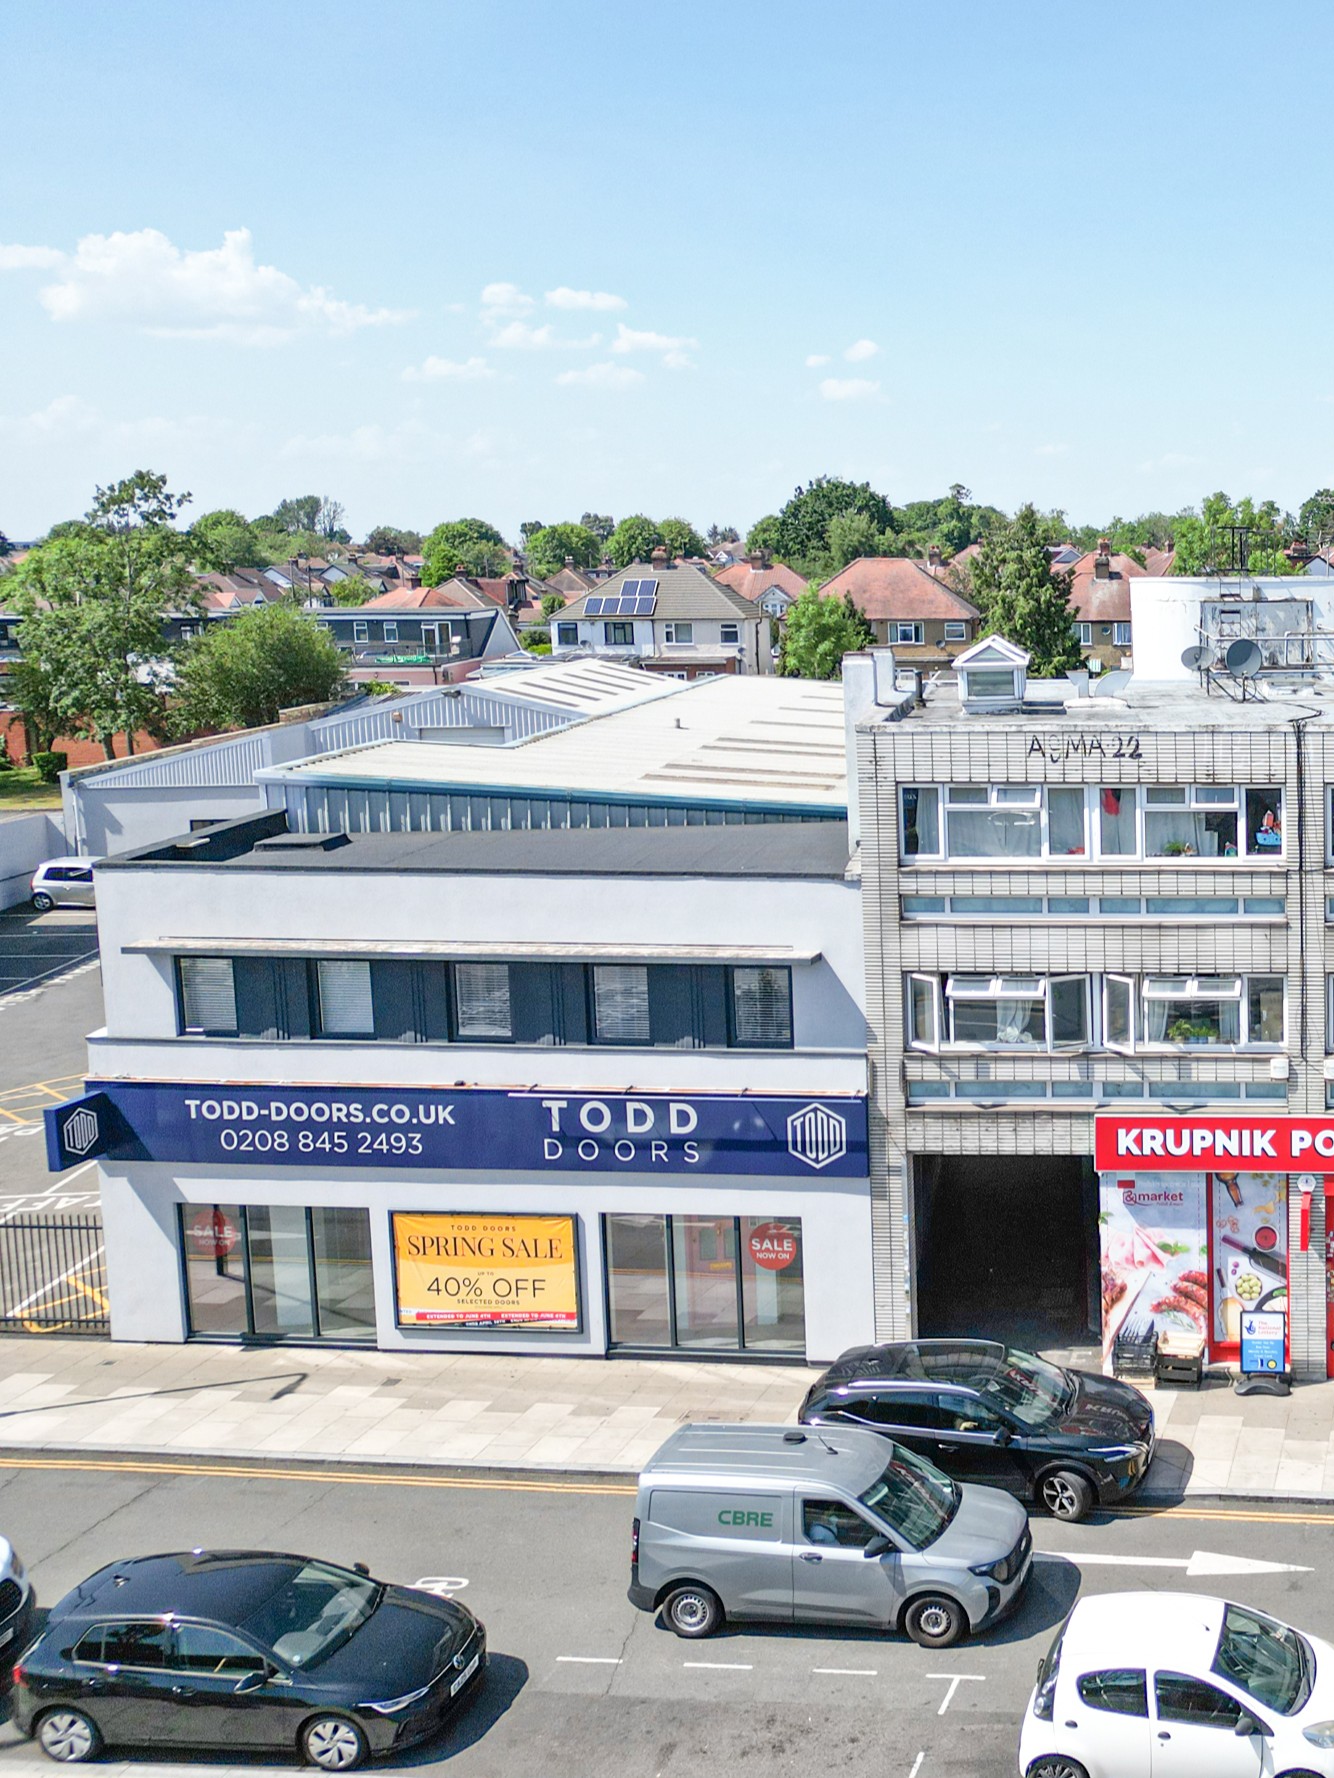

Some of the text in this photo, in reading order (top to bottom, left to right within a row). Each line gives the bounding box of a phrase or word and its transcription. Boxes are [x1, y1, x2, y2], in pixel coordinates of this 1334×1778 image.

[184, 1099, 456, 1125] TODD-DOORS.CO.UK
[542, 1100, 698, 1135] TODD
[220, 1128, 423, 1155] 0208 845 2493
[544, 1138, 700, 1164] DOORS
[1116, 1128, 1278, 1158] KRUPNIK
[193, 1225, 233, 1238] SALE
[451, 1224, 477, 1232] TODD
[407, 1234, 563, 1259] SPRING SALE
[751, 1238, 793, 1251] SALE
[427, 1276, 546, 1298] 40% OFF
[718, 1509, 774, 1528] CBRE
